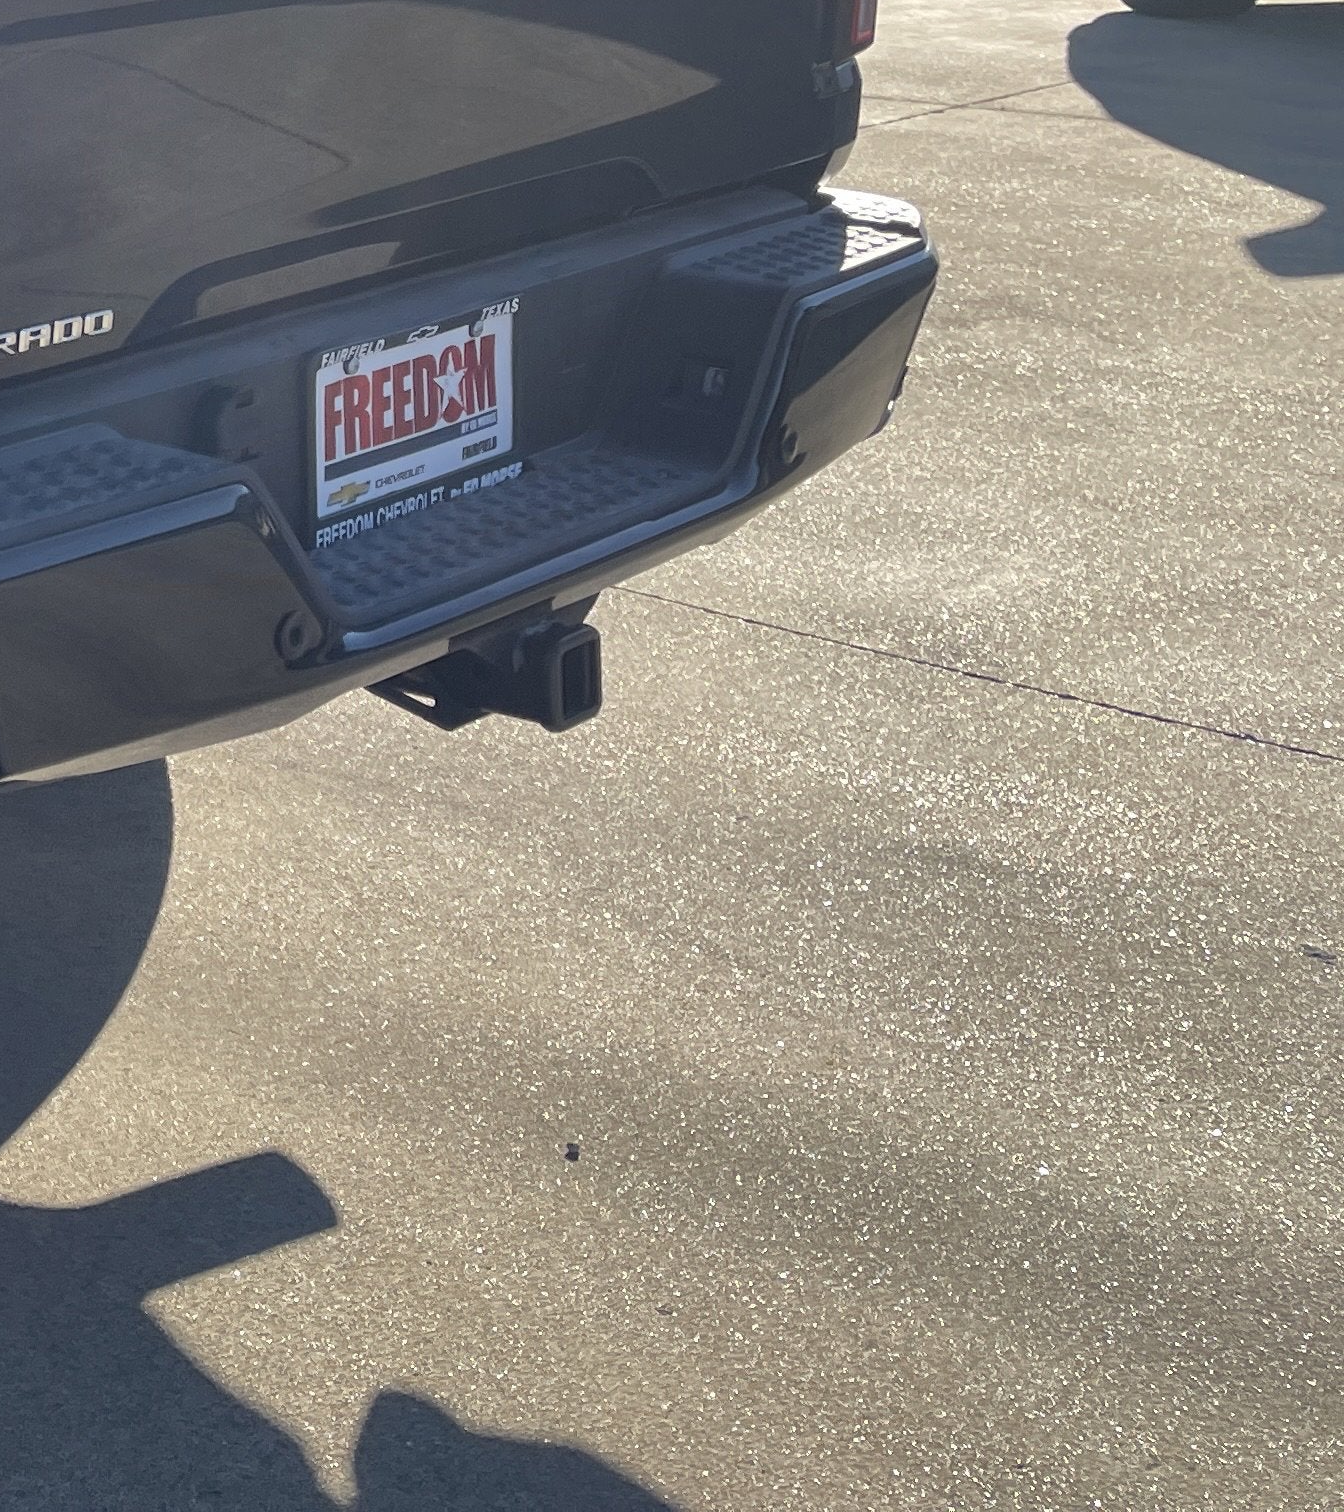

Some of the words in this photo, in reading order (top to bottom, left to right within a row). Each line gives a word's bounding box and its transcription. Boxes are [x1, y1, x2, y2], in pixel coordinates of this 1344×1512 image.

[321, 338, 386, 368] FAIRFIELD
[481, 297, 520, 321] TEXAS
[324, 334, 496, 463] FREEDOM
[316, 511, 374, 549] FREEDOM
